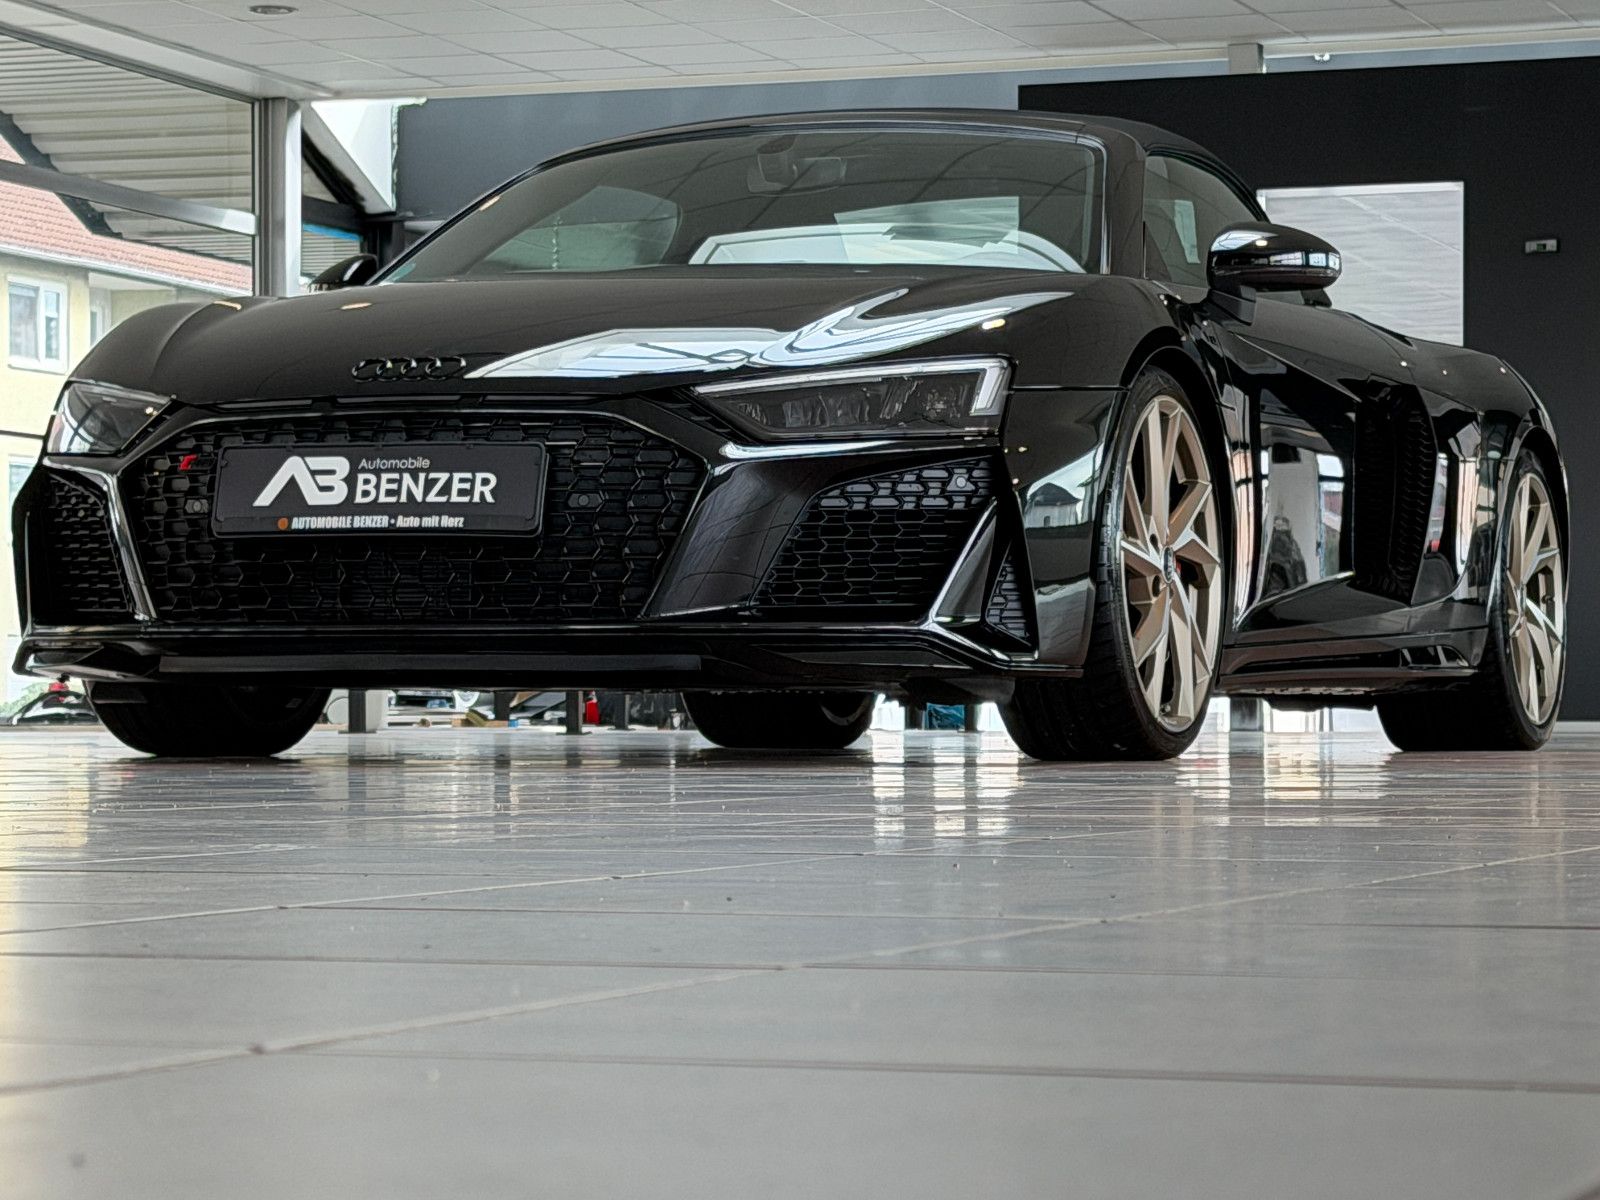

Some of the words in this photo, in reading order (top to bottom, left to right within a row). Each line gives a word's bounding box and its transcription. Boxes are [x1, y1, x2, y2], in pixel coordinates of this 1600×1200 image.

[358, 457, 431, 470] Automobile
[353, 472, 498, 504] BENZER
[291, 516, 352, 530] AUTOMOBILE
[353, 515, 389, 528] BENZER
[396, 515, 420, 528] Auto
[421, 515, 440, 528] mit
[440, 515, 464, 528] Herz
